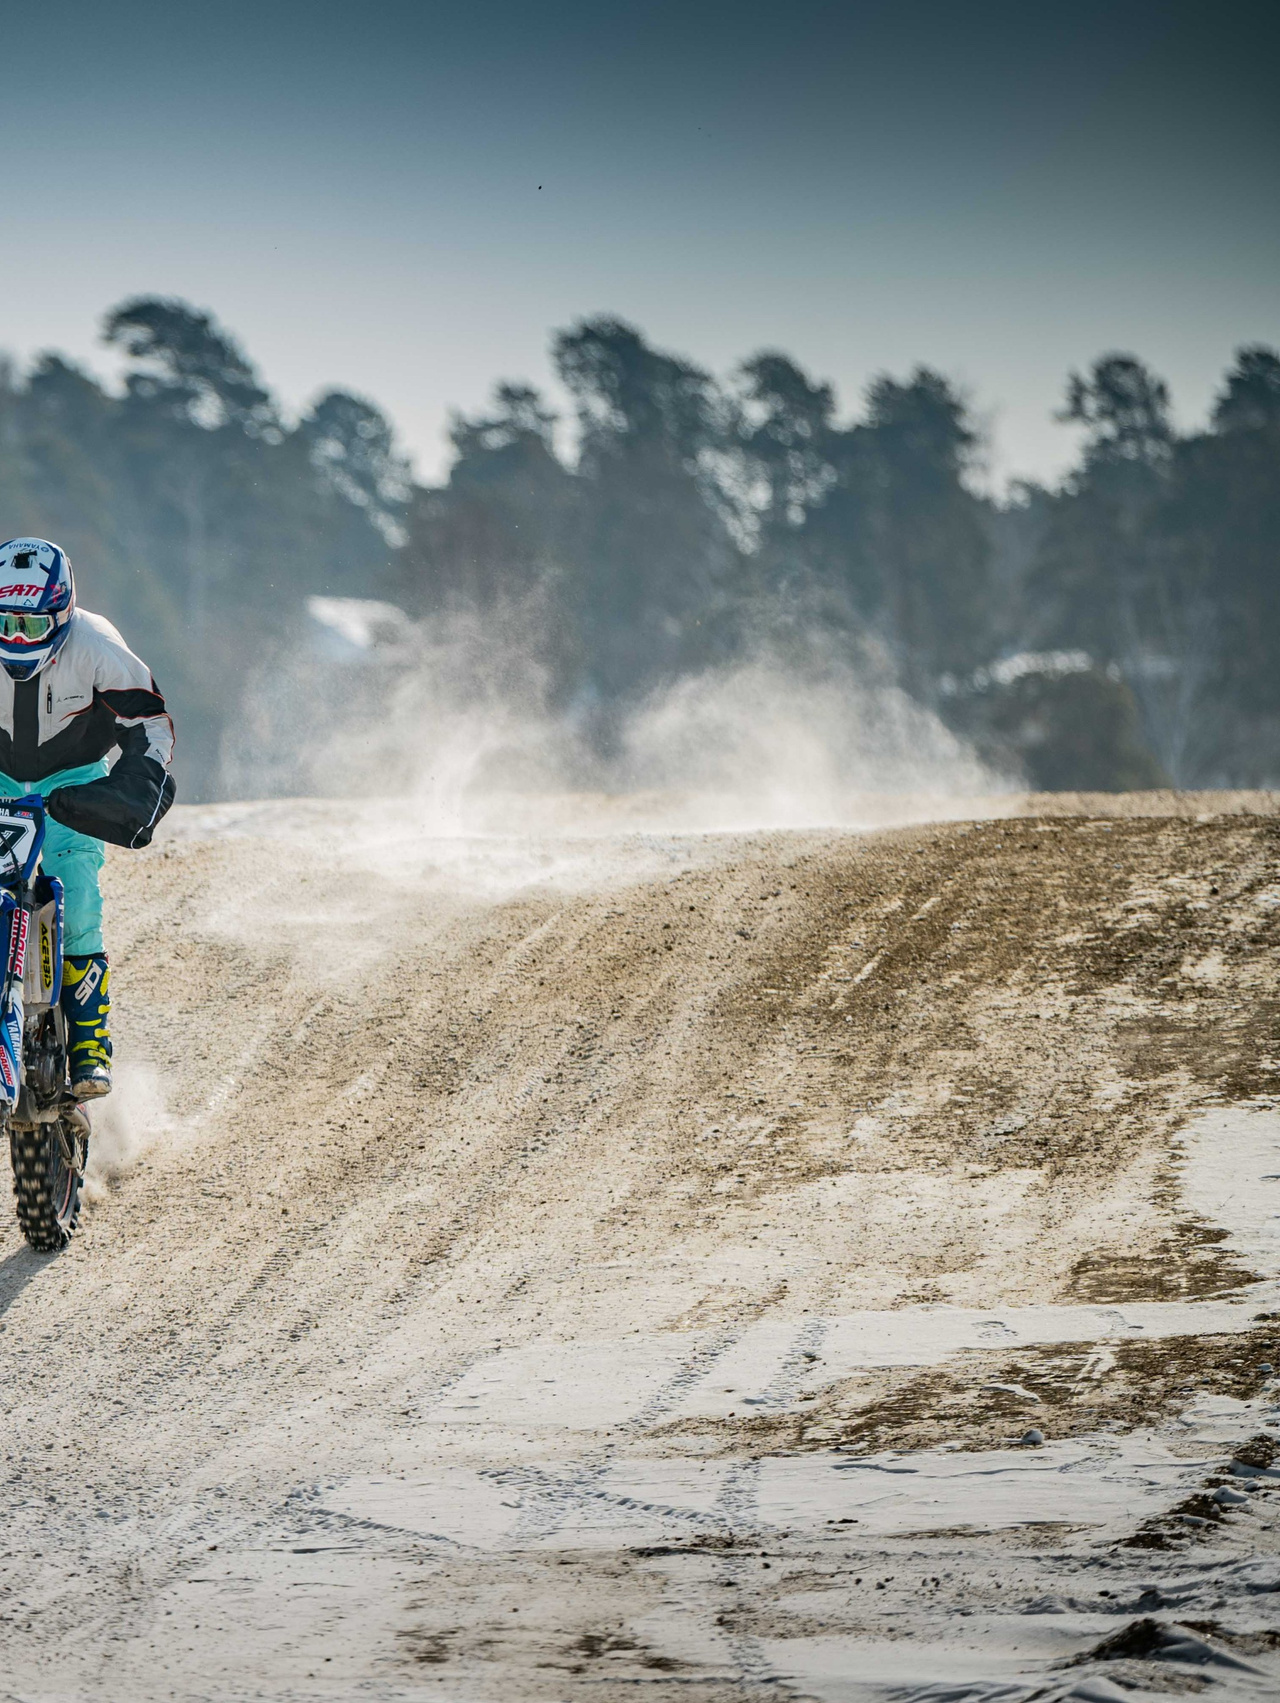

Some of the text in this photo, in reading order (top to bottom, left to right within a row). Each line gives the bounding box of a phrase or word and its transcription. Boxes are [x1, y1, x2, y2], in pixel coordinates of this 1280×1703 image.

[8, 543, 41, 551] YAMAHA
[74, 961, 103, 1006] SIDI
[7, 1020, 21, 1062] YAMAHA
